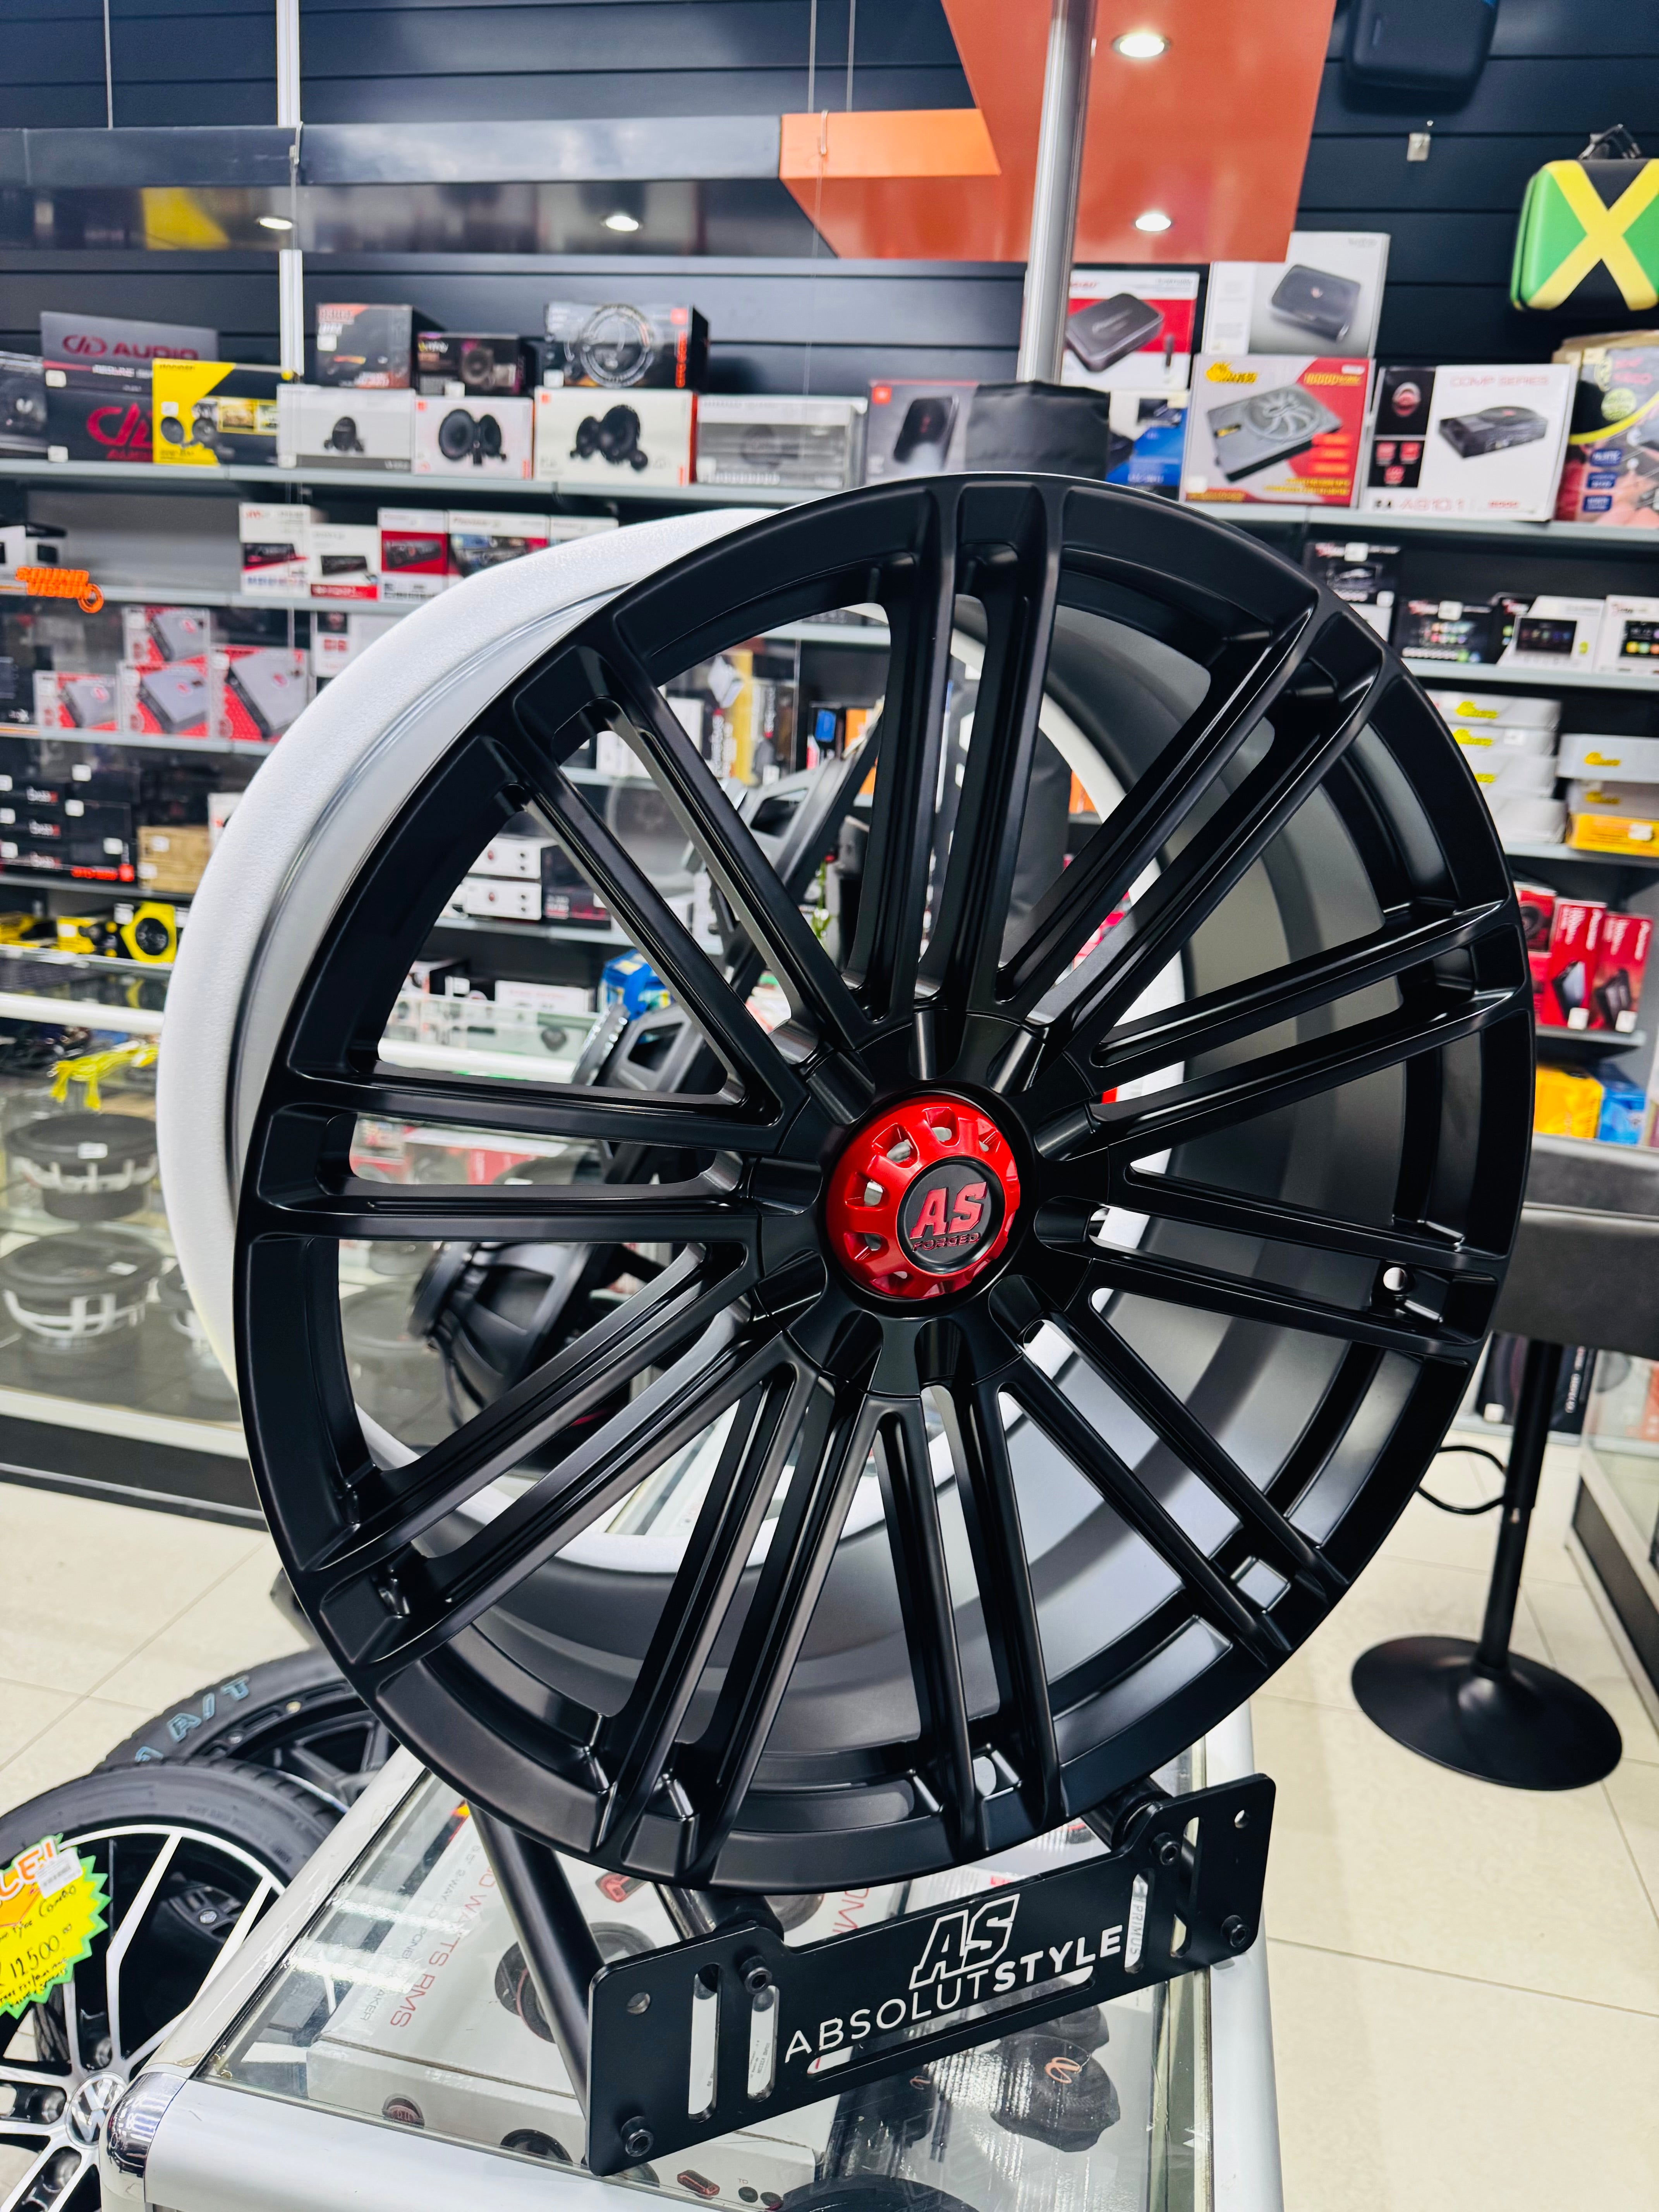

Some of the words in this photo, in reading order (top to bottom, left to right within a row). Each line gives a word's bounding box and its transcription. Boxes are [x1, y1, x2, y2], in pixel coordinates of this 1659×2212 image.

[909, 1181, 987, 1239] AS
[912, 1232, 981, 1252] FORGED
[908, 1893, 1020, 1989] AS
[1129, 1904, 1143, 1954] PRIMUS
[390, 1973, 436, 2028] RMS
[784, 1924, 1123, 2063] ABSOLUTSTYLE
